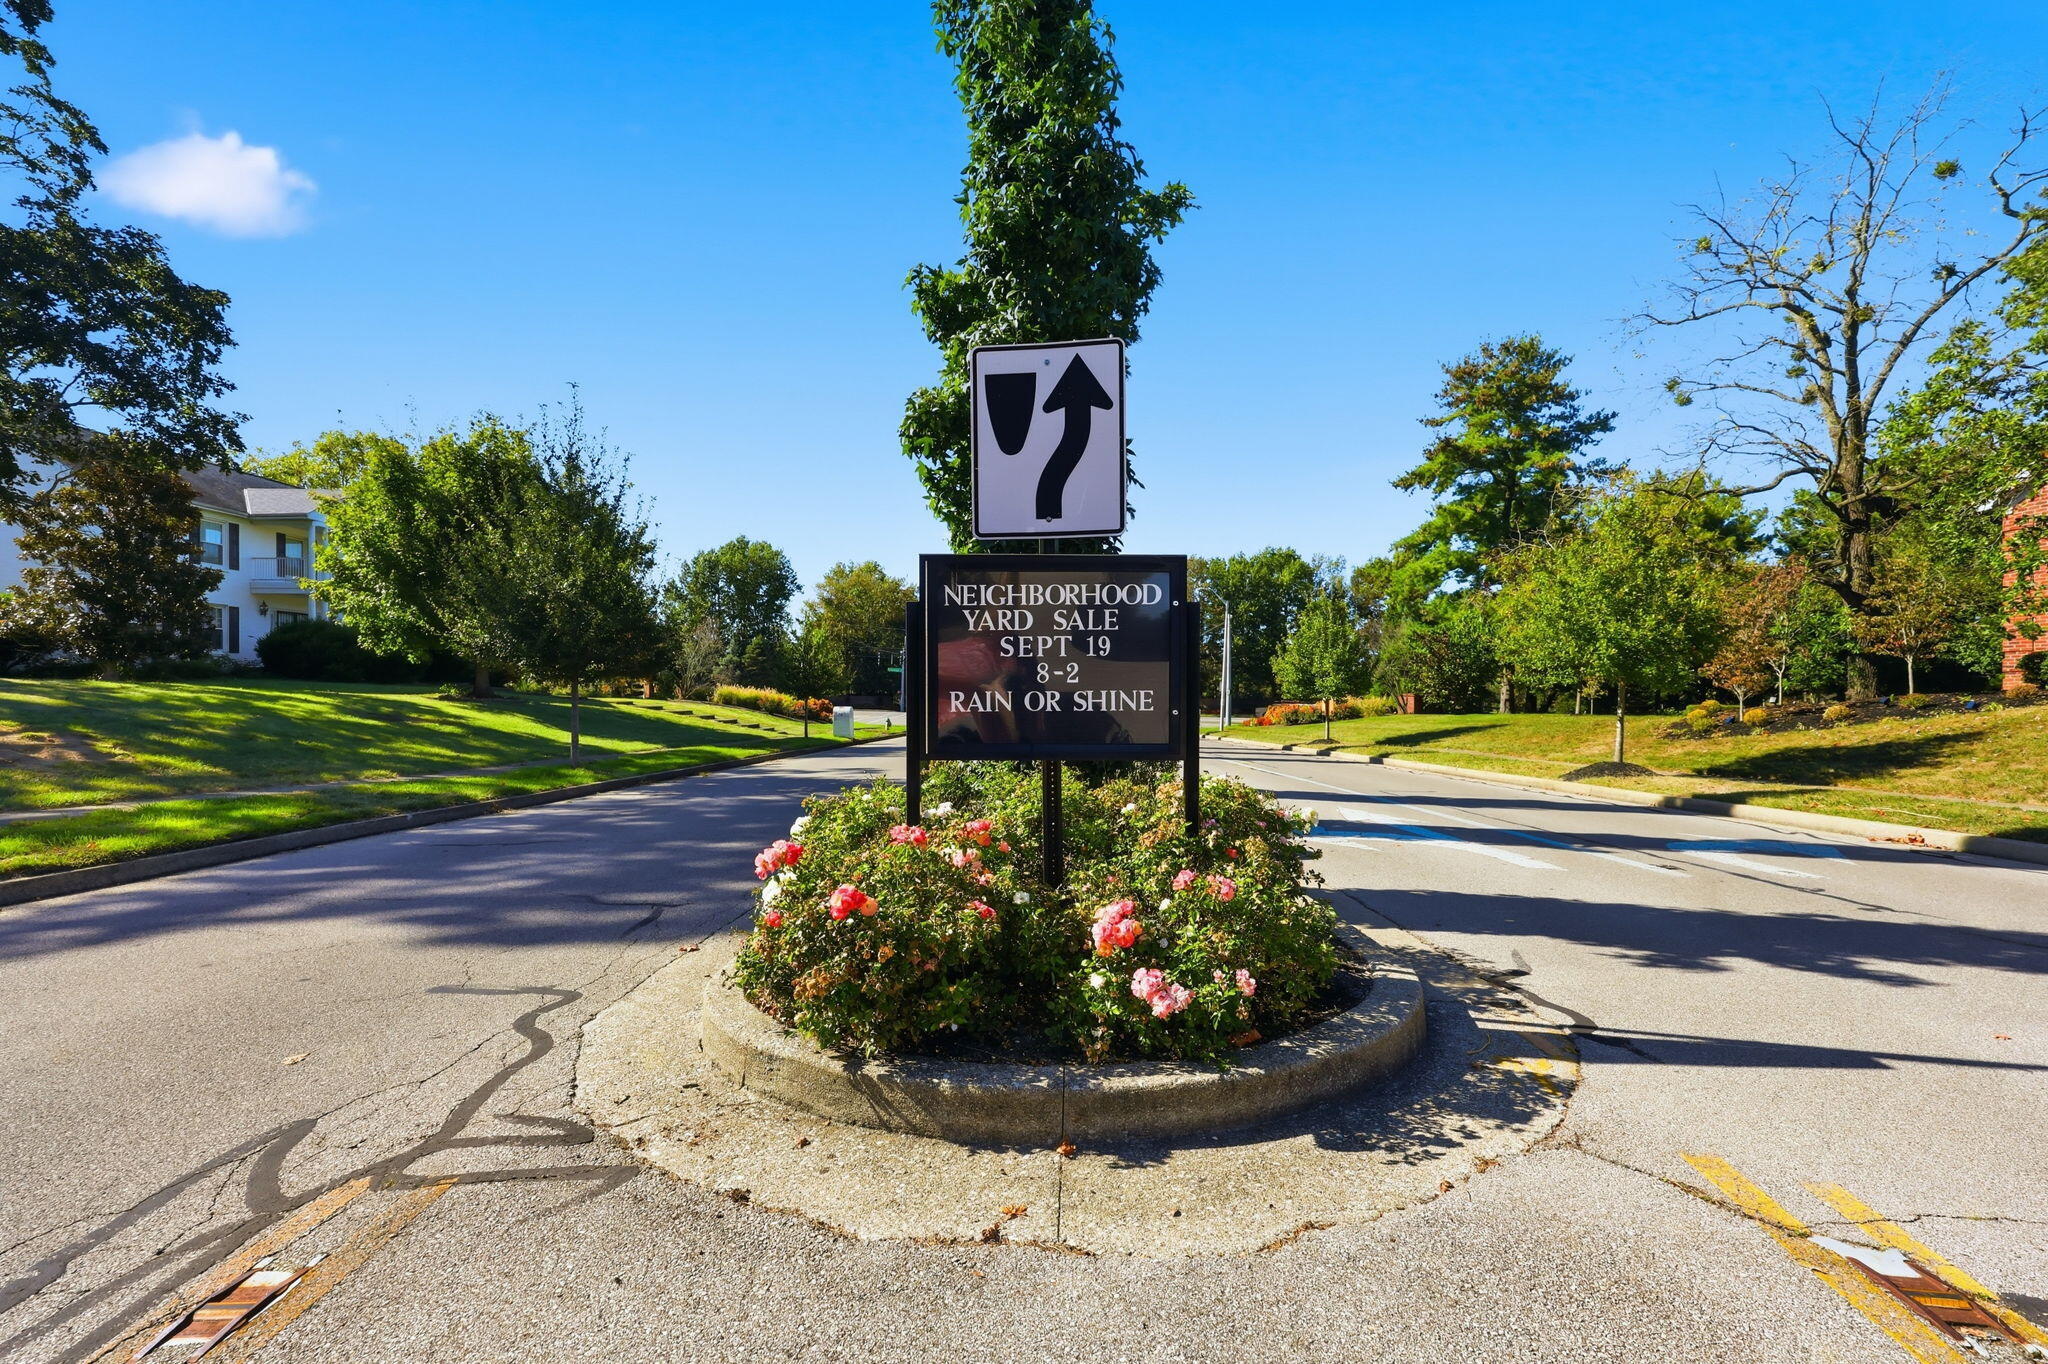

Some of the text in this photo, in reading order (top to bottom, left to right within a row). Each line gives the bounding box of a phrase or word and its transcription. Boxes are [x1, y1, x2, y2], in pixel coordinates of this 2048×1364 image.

[943, 583, 1163, 606] NEIGHBORHOOD
[962, 609, 1119, 631] YARD SALE
[1000, 635, 1111, 657] SEPT 19
[1036, 662, 1079, 684] 8-2
[949, 689, 1154, 713] RAIN OR SHINE
